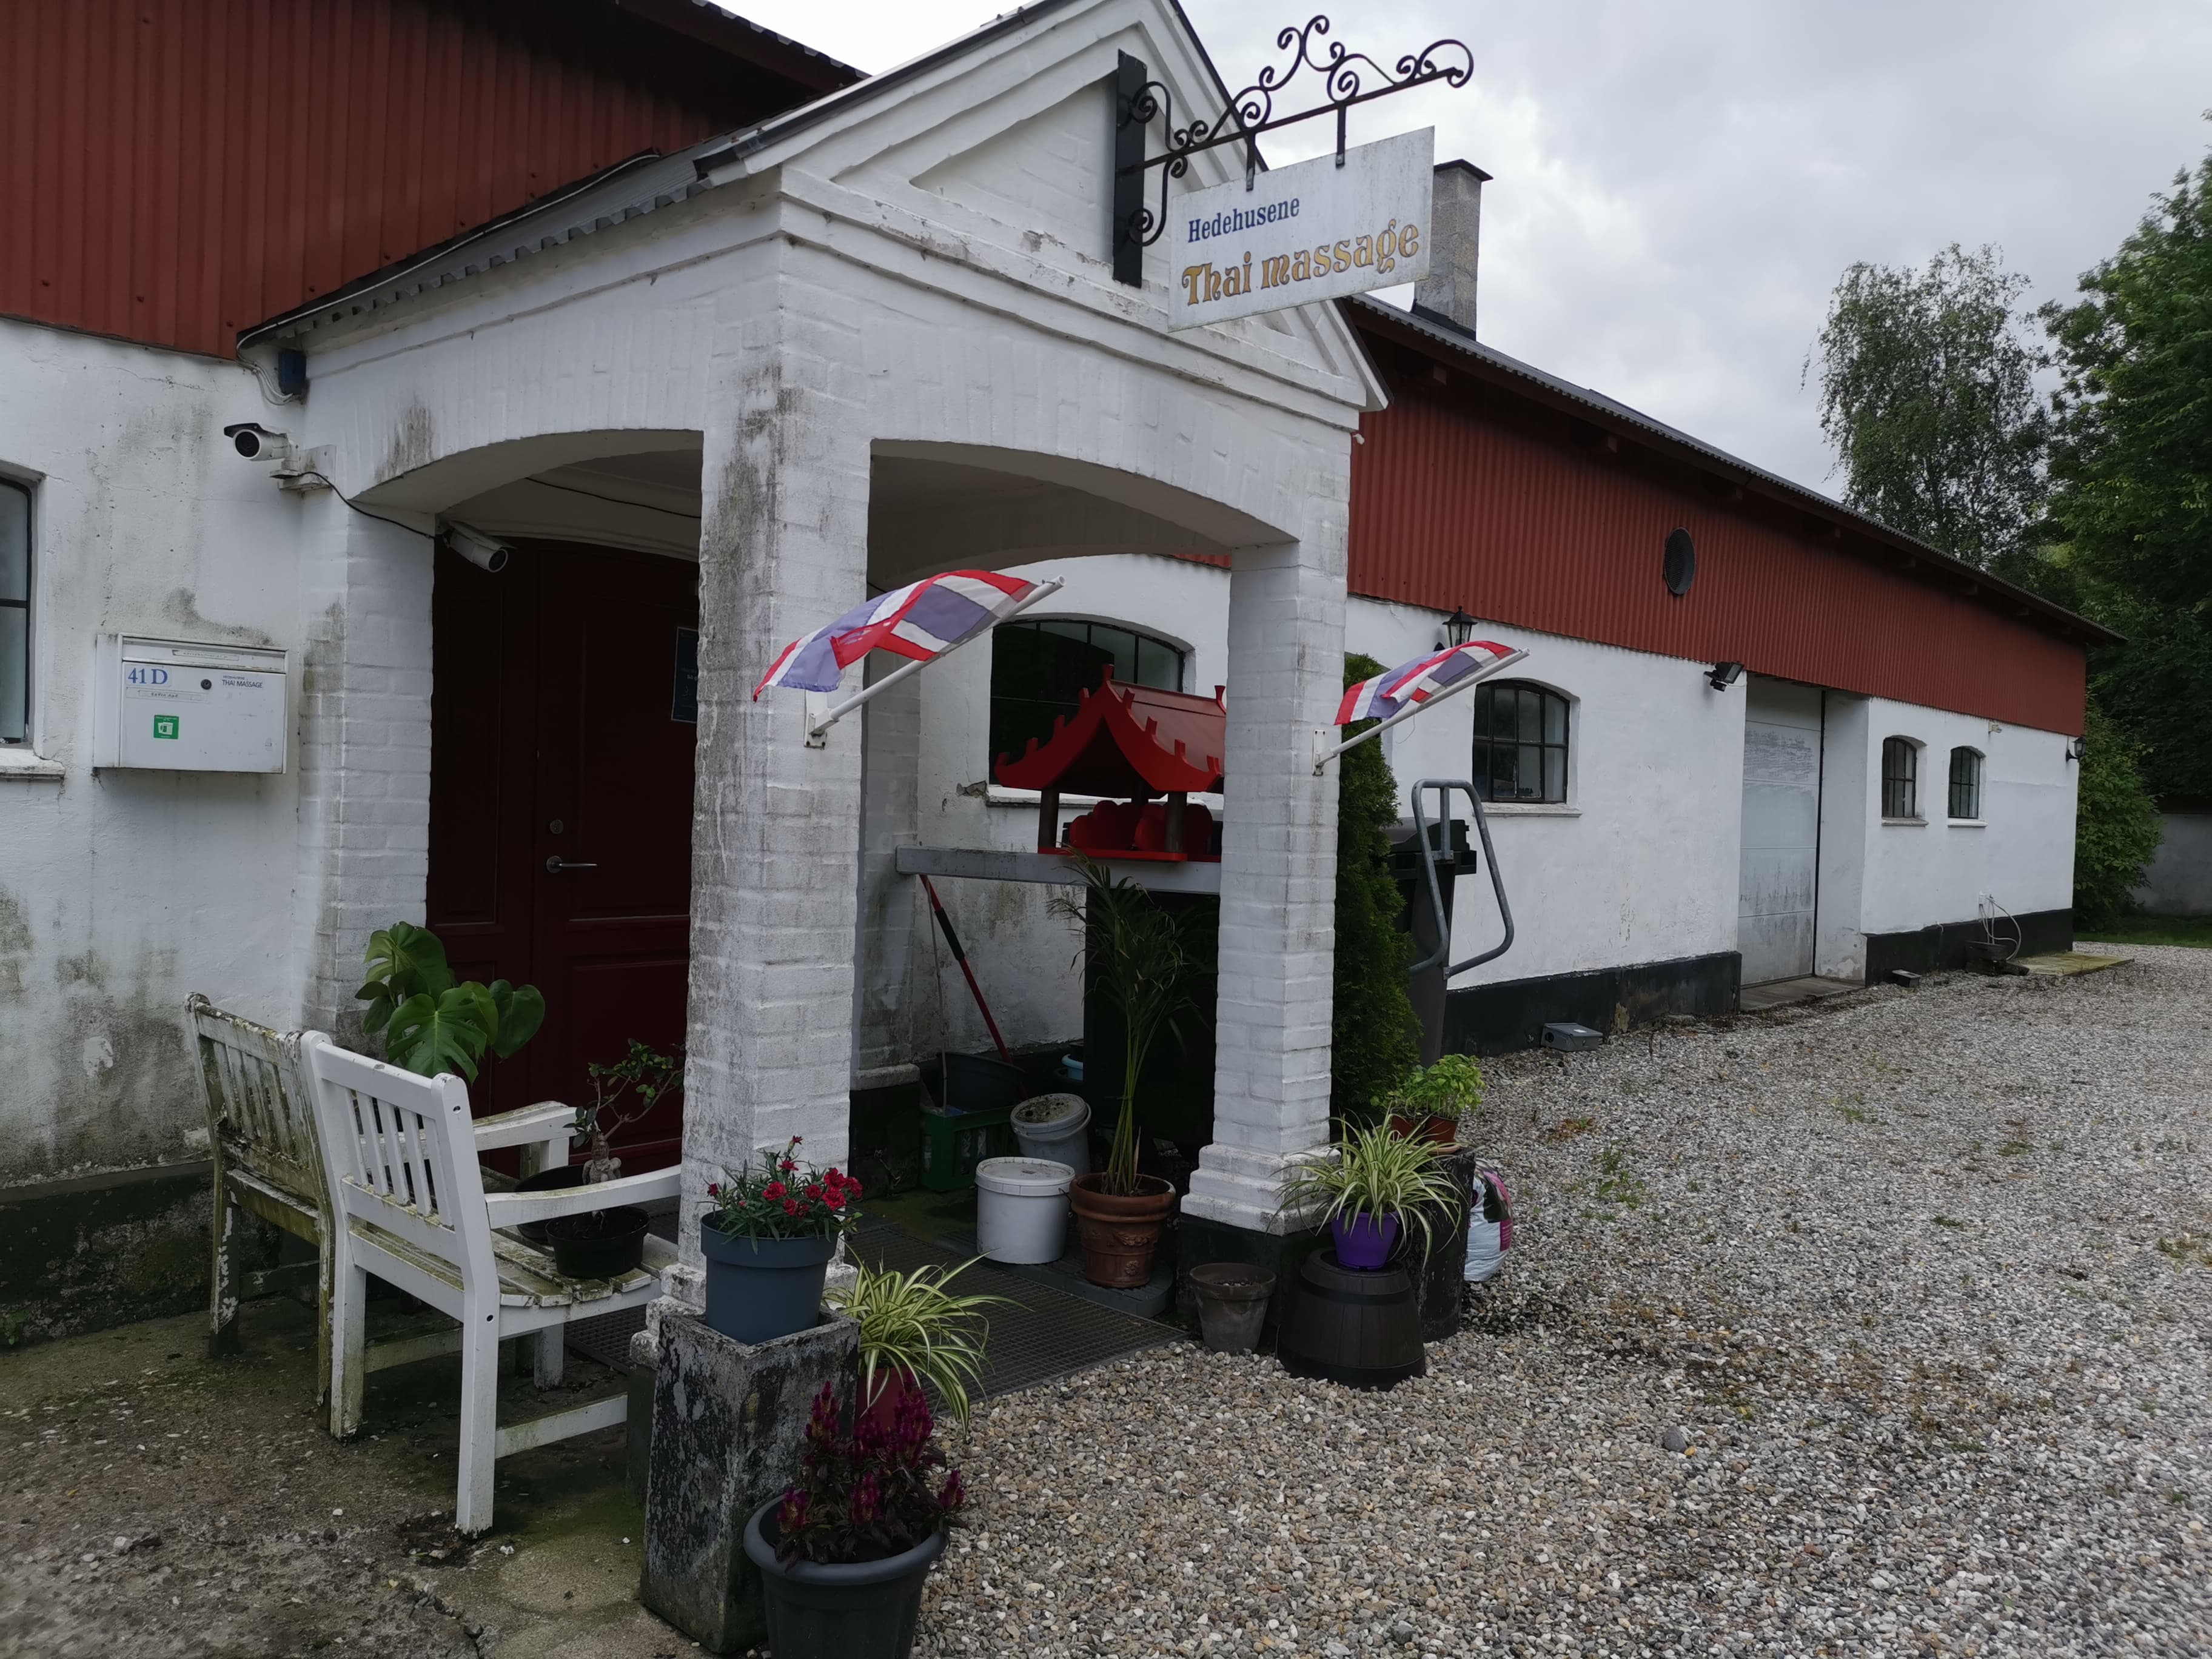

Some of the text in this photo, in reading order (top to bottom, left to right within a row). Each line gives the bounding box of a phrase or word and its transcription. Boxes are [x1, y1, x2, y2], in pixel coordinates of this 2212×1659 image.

[1188, 198, 1300, 243] Hedehusene
[1181, 218, 1419, 306] Thai massage
[127, 668, 168, 685] 41 D
